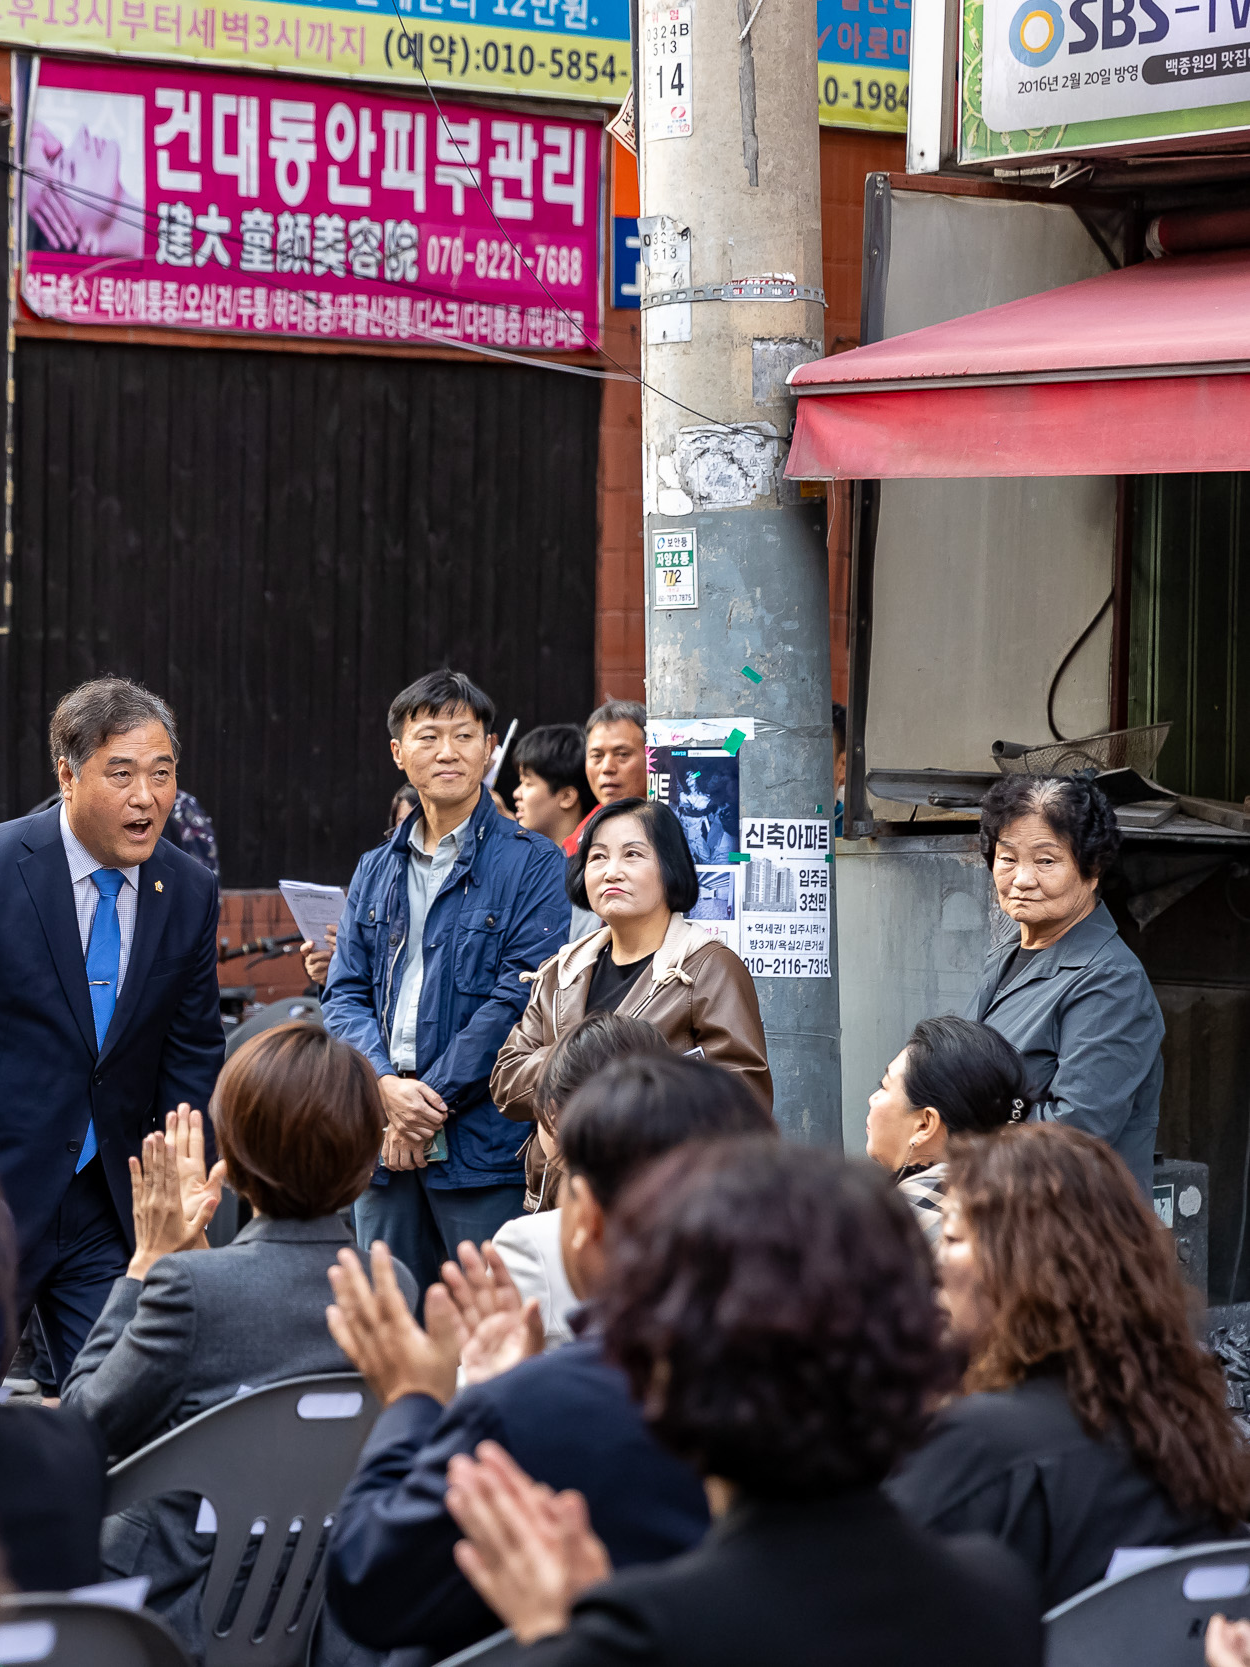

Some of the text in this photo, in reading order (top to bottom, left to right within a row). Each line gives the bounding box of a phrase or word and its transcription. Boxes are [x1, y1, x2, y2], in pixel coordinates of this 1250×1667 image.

[653, 40, 677, 56] 513
[1165, 45, 1250, 77] 백종원의 맛집
[656, 62, 684, 98] 14
[817, 75, 909, 113] 0-1984
[1017, 64, 1139, 95] 2016년 2월 20일 방영
[153, 87, 586, 226] 건대동안피부관리
[745, 822, 828, 850] 신축아파트
[799, 869, 828, 888] 입주금
[799, 893, 827, 911] 3천만
[755, 923, 786, 934] 역세권!
